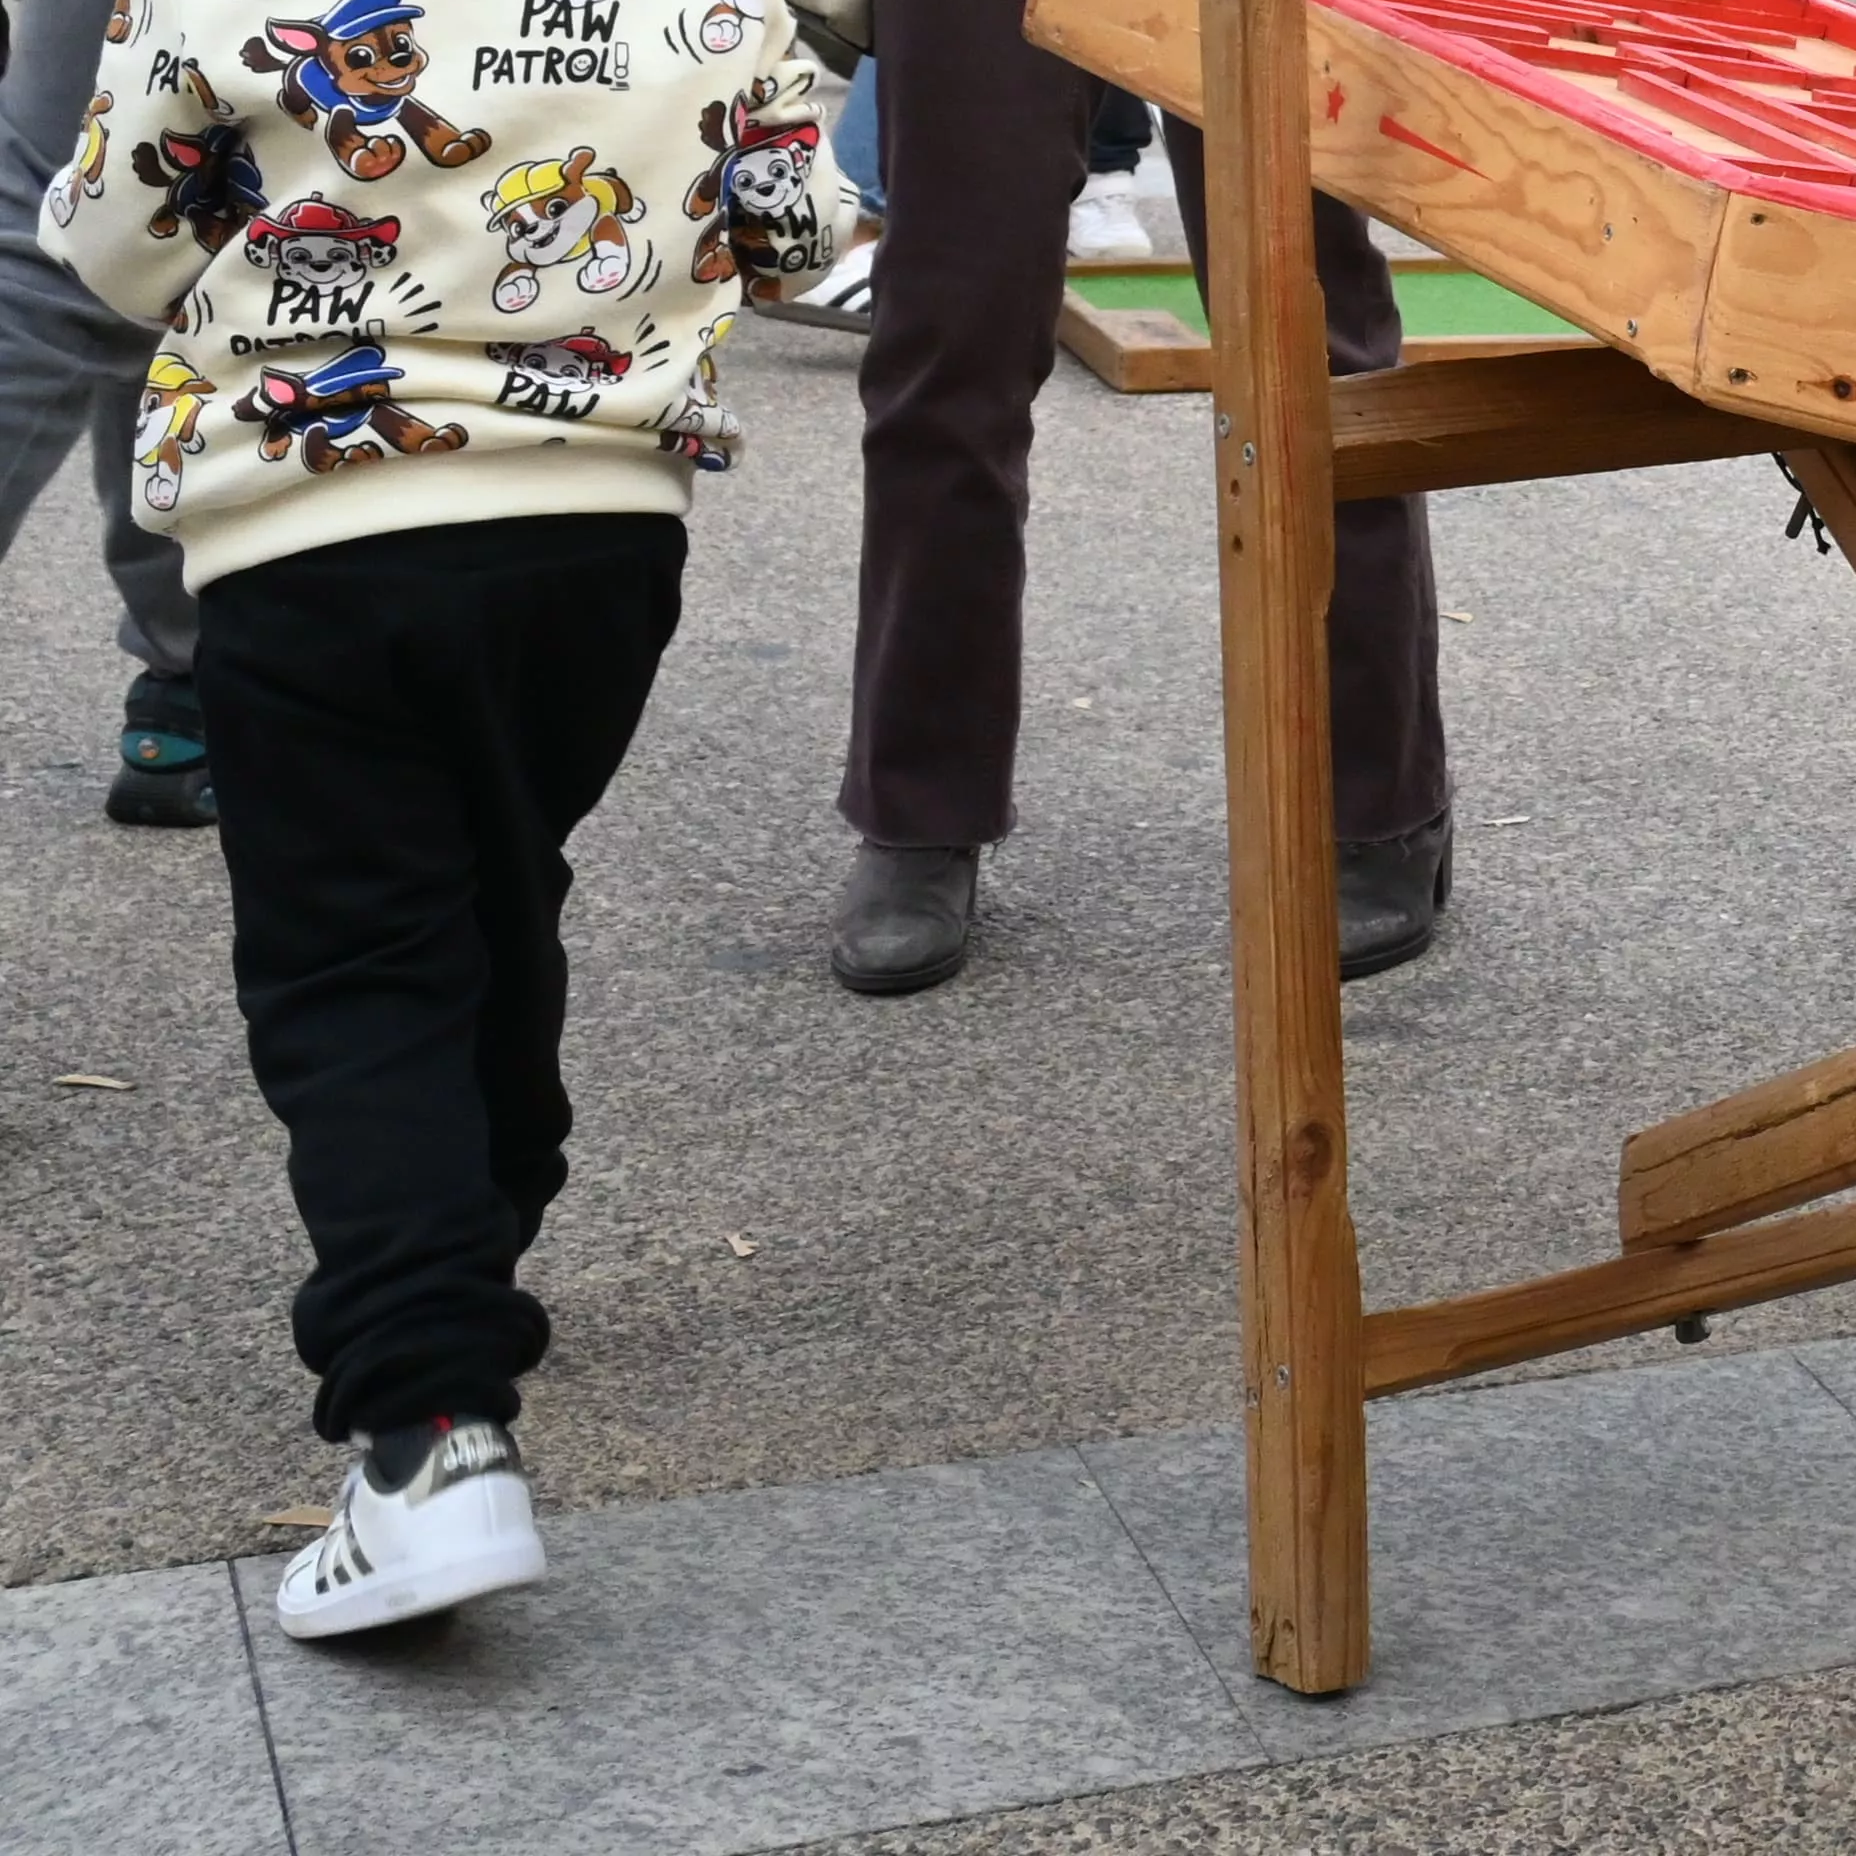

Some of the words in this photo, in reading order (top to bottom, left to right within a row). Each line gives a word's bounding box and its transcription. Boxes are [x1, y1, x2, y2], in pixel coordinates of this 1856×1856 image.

[472, 41, 630, 91] PATROL!
[267, 279, 375, 326] PAW
[496, 371, 600, 419] PAW
